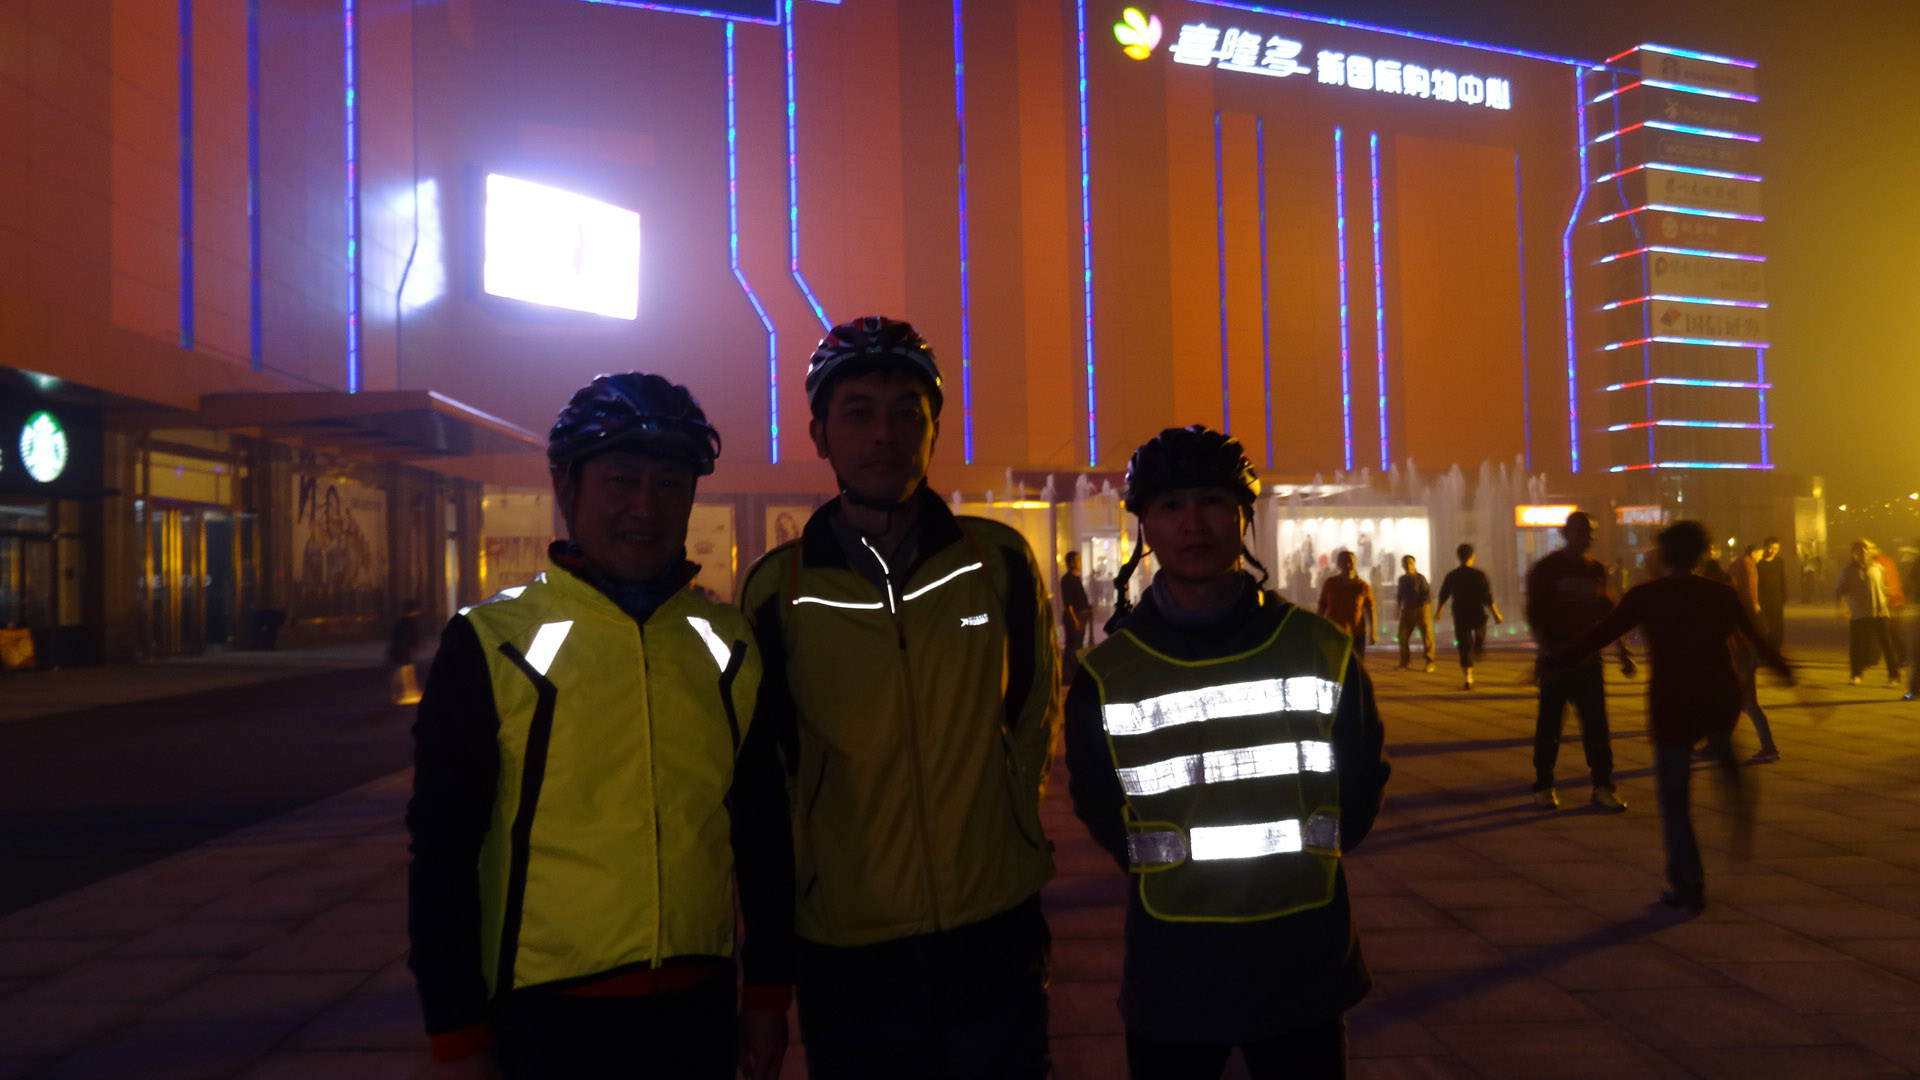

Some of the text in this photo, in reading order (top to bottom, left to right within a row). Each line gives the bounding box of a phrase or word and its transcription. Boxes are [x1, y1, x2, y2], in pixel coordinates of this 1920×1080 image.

[1169, 23, 1511, 110] 喜隆多 新国际购物中心
